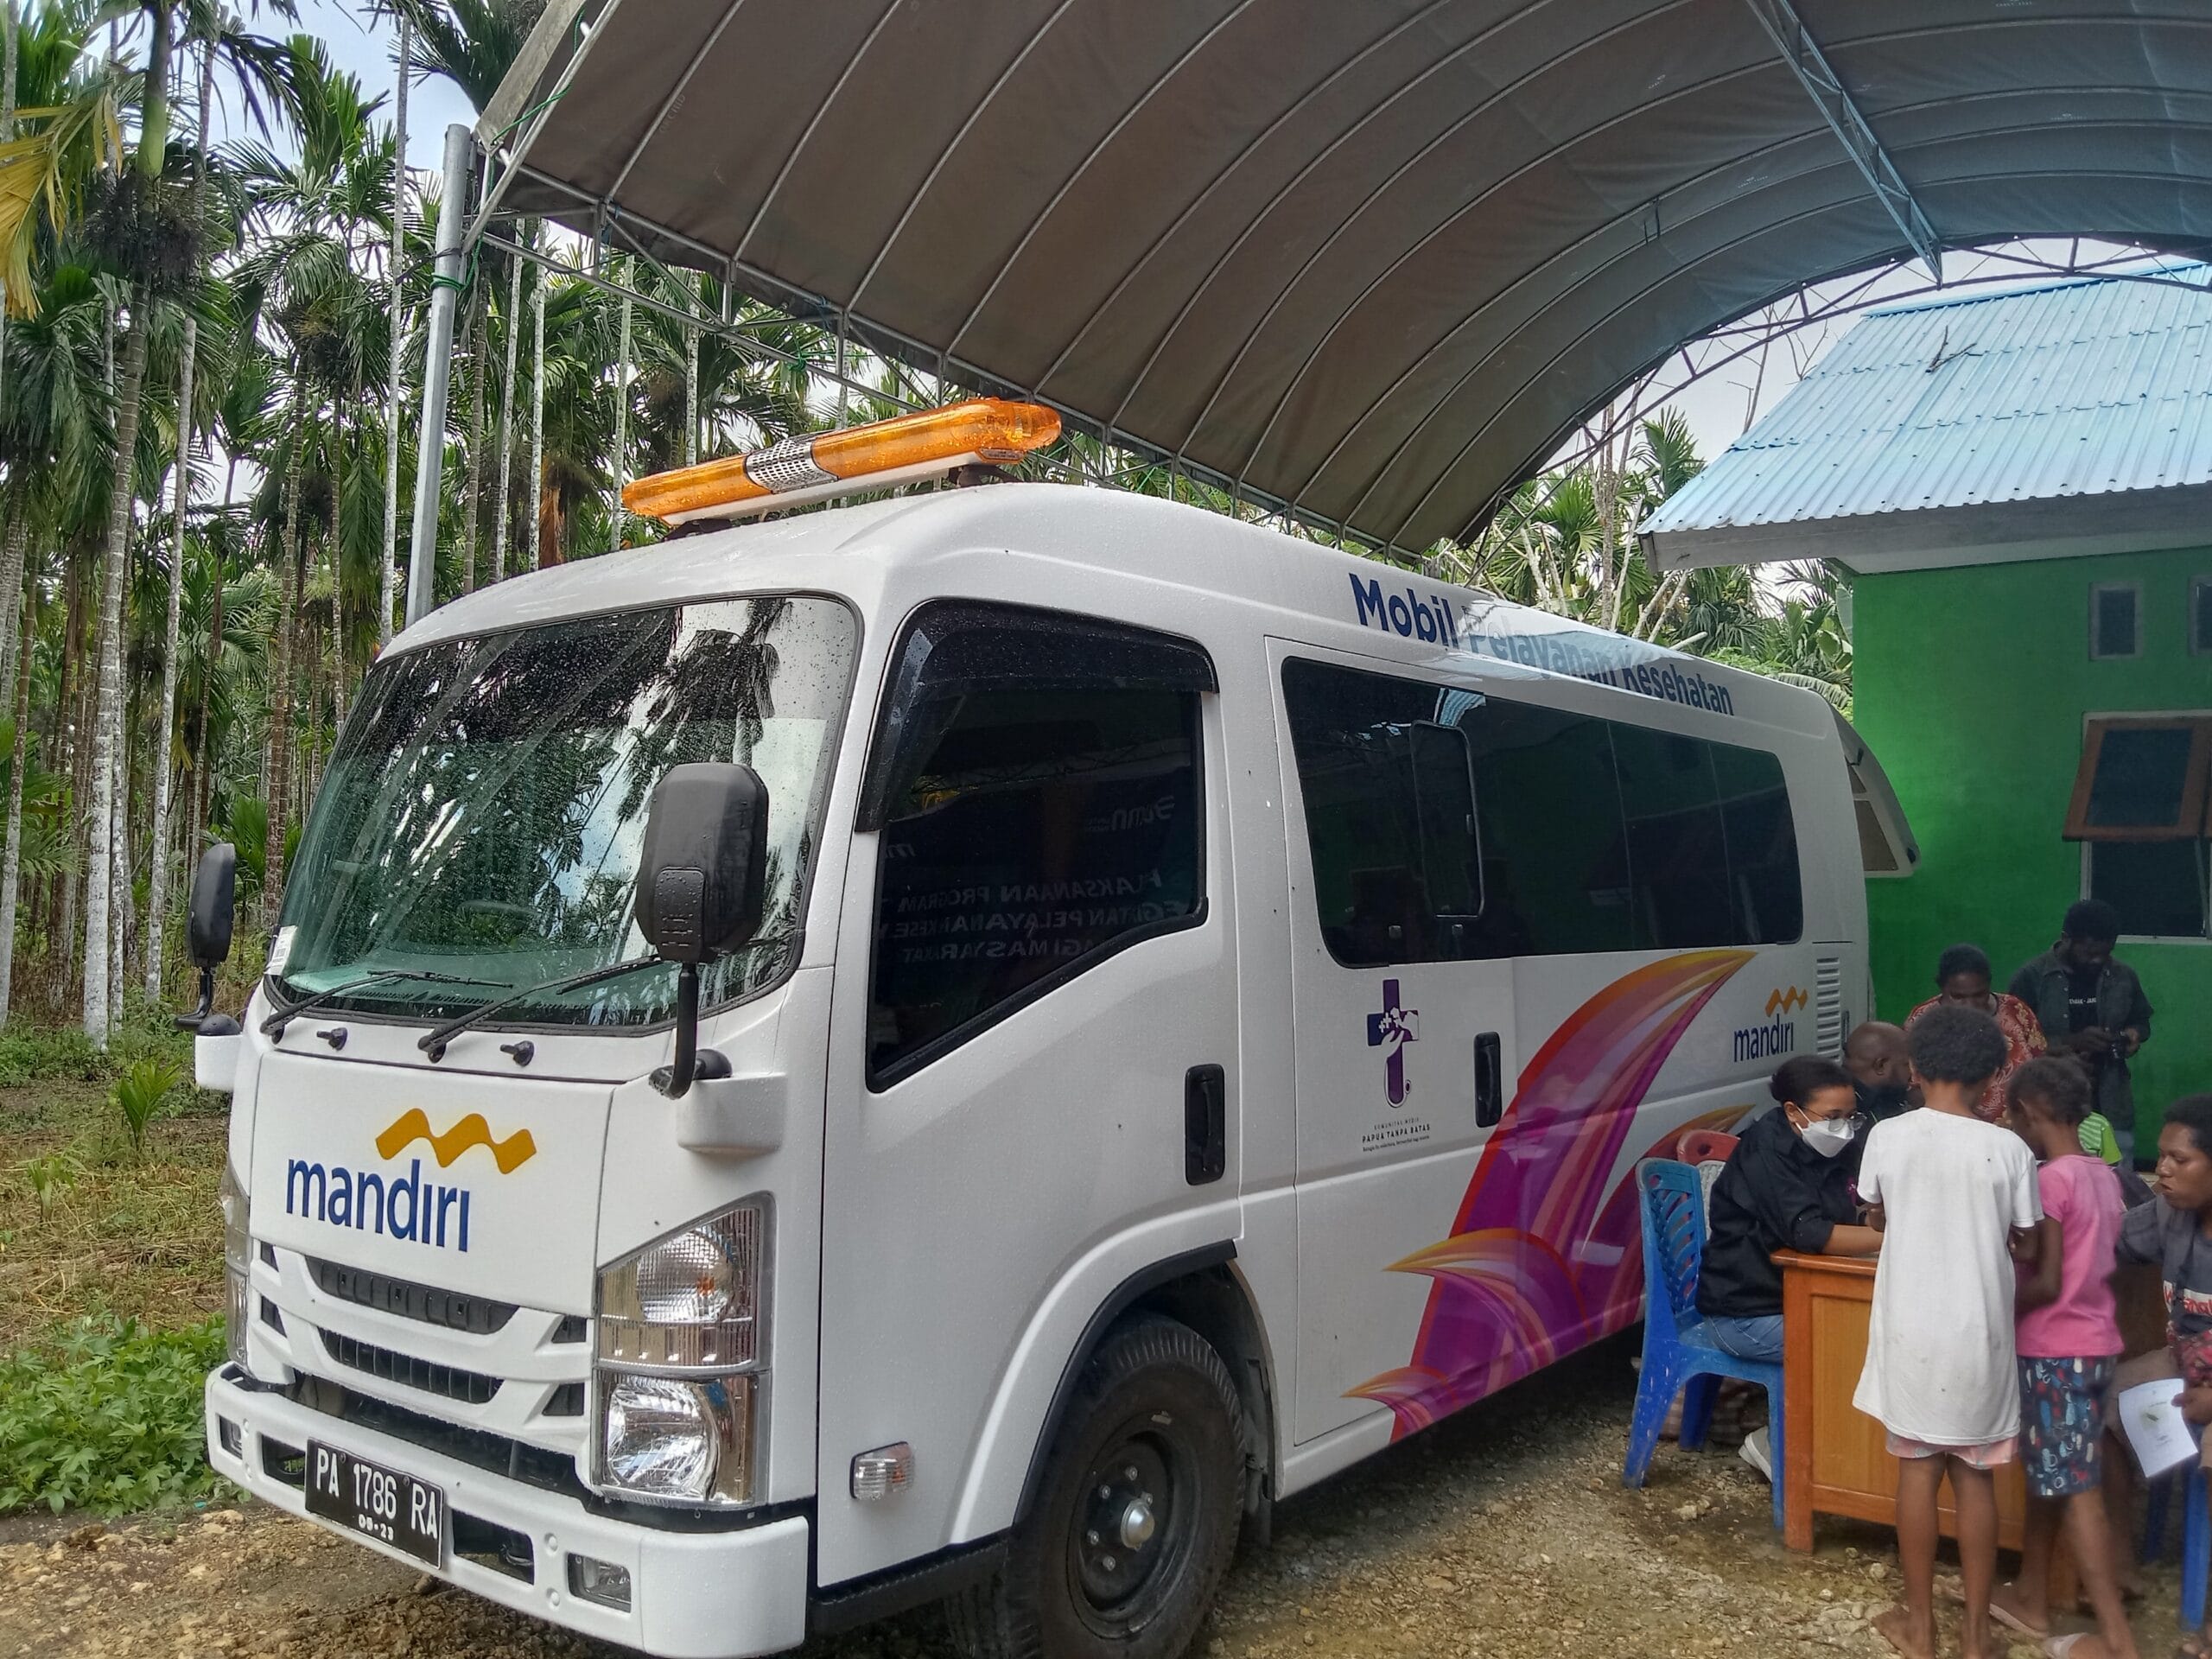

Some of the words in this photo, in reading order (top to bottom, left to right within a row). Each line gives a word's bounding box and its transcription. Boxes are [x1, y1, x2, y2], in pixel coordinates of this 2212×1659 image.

[1347, 572, 1460, 650] Mobil
[1461, 606, 1618, 688] Pelayanan
[1618, 650, 1734, 716] Kesehatan
[1733, 1013, 1794, 1063] mandiri
[1362, 1132, 1384, 1144] PAPUA
[1386, 1128, 1408, 1138] TANPA
[1410, 1123, 1431, 1134] BATAS
[286, 1158, 470, 1253] mandiri
[316, 1447, 340, 1498] PA
[353, 1463, 397, 1520] 1786
[410, 1483, 438, 1540] RA
